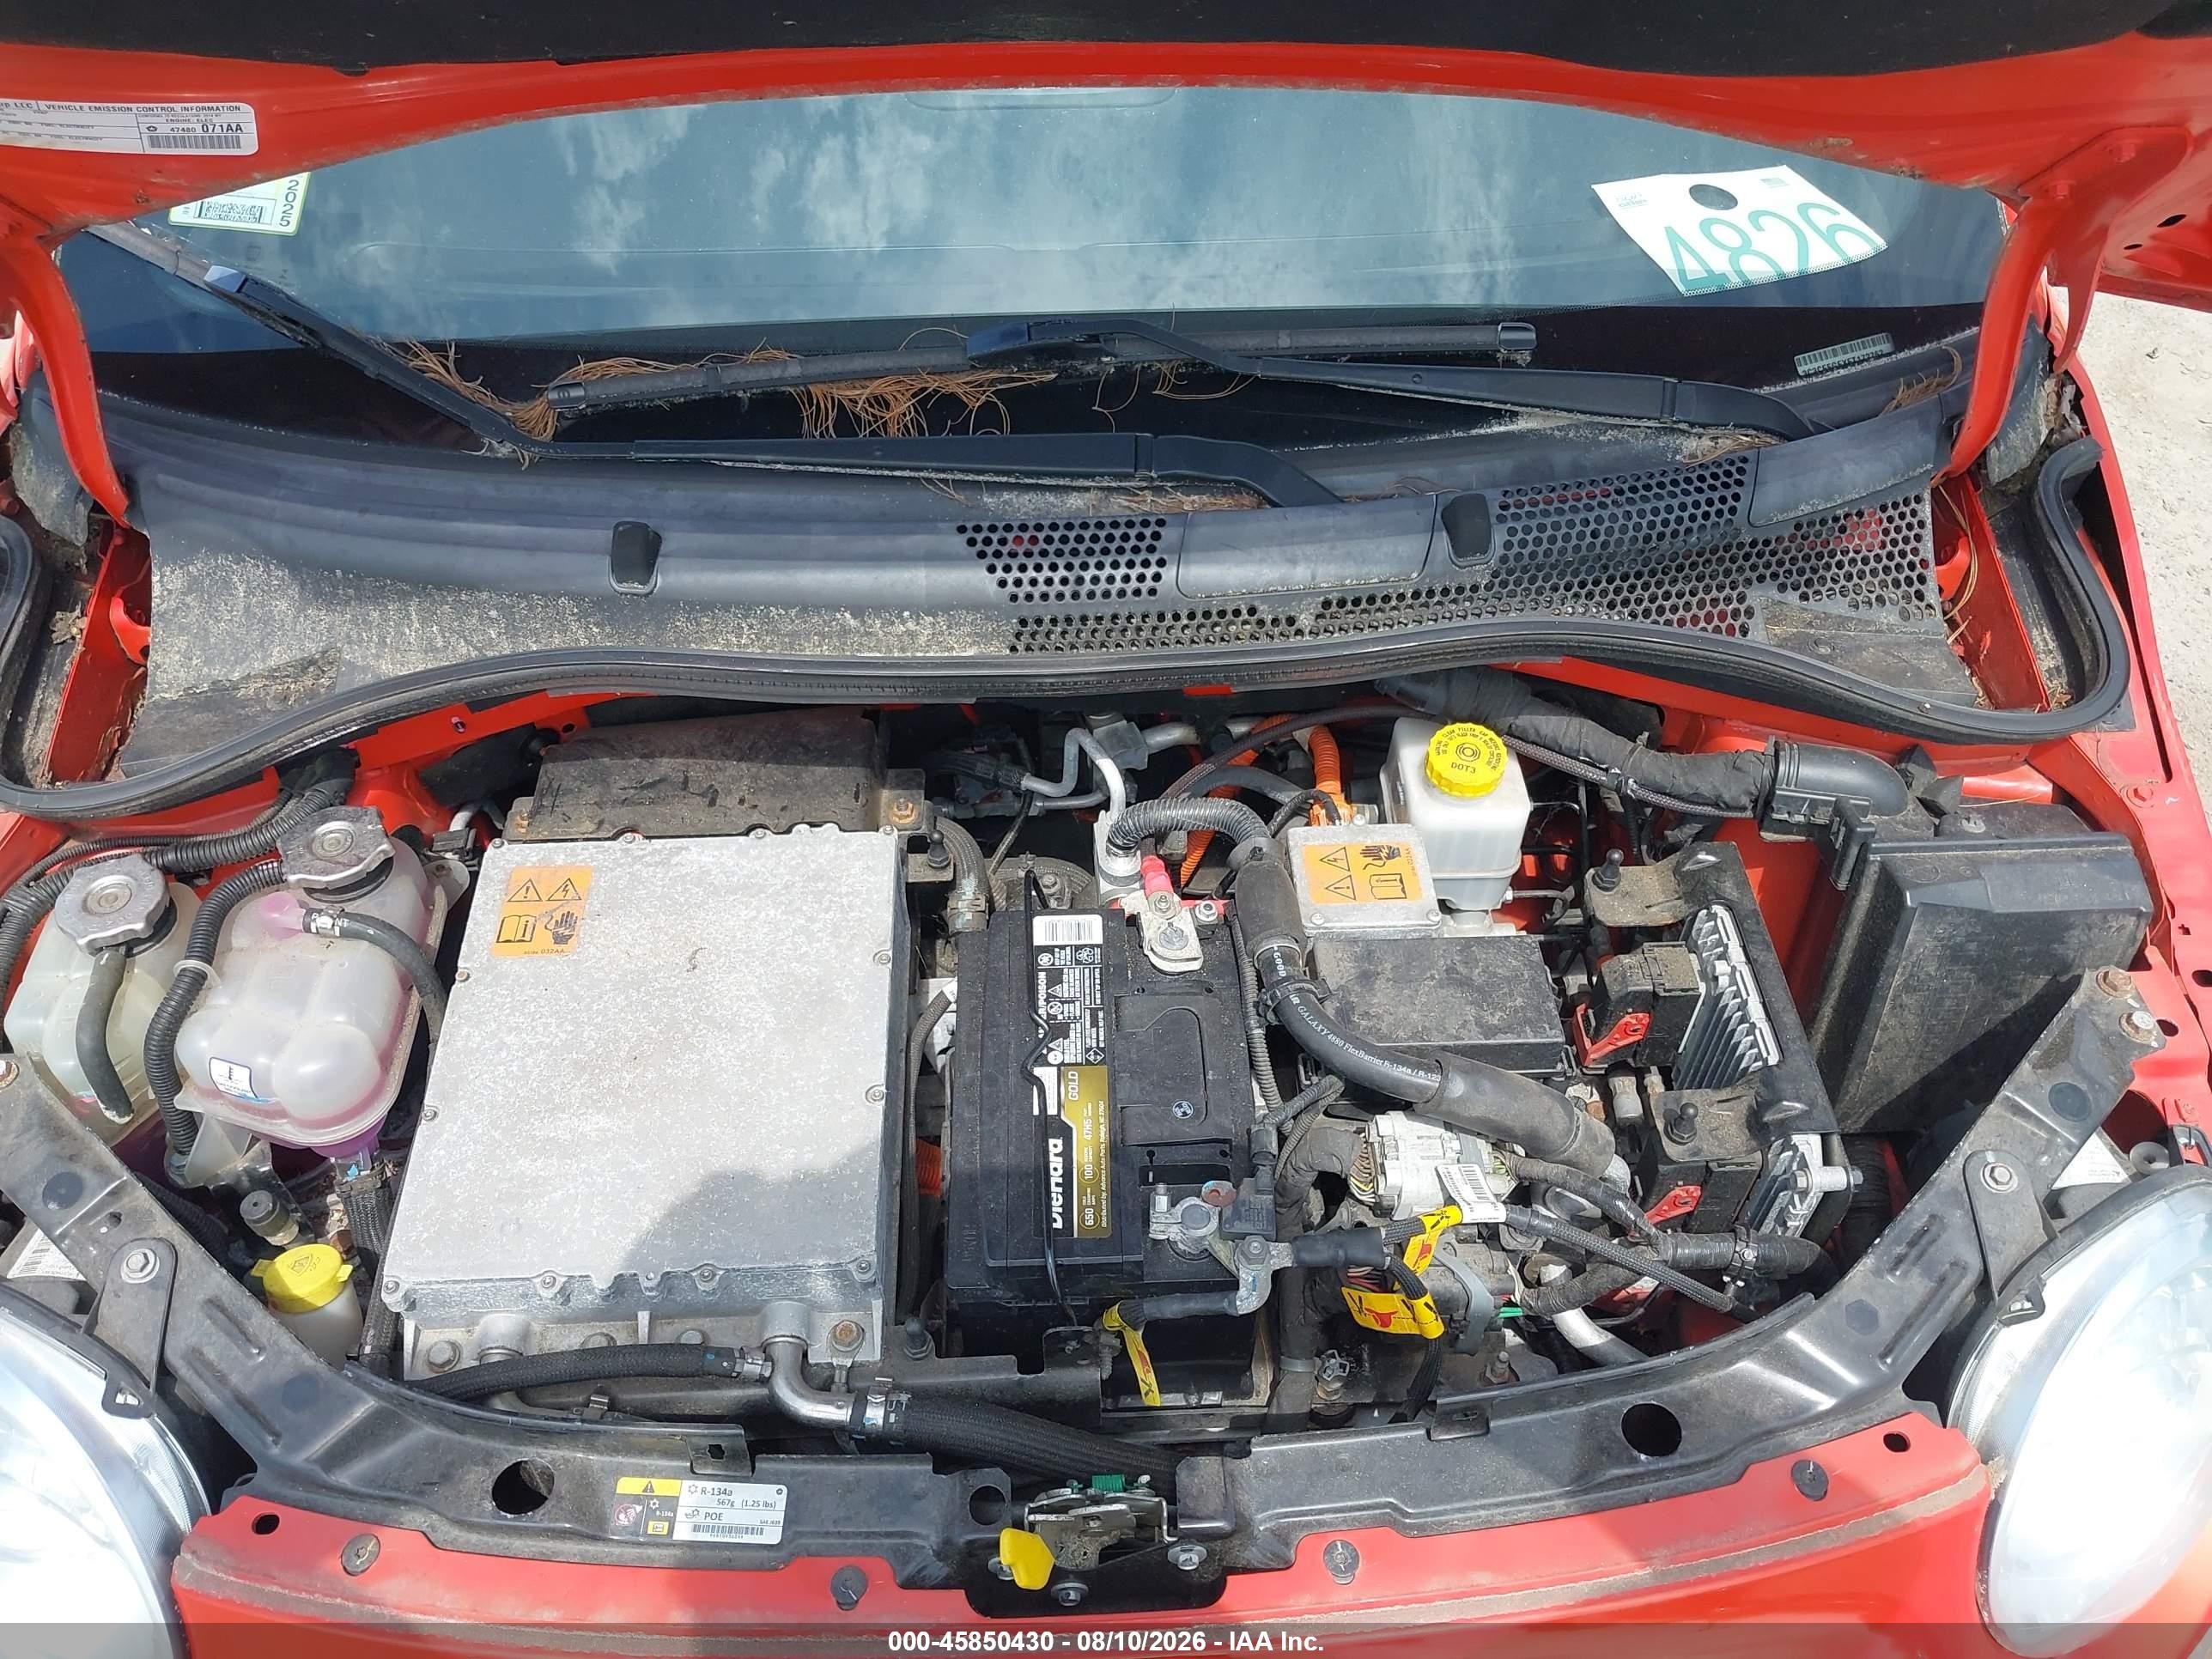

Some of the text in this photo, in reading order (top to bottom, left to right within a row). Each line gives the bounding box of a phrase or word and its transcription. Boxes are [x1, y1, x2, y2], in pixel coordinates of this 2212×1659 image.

[201, 124, 244, 133] 071AA
[279, 179, 300, 227] 2025
[1664, 202, 1878, 290] 4826
[1451, 762, 1476, 774] DOT3
[1297, 1006, 1331, 1036] GALAXY
[1327, 1032, 1345, 1047] 4880
[1343, 1042, 1384, 1066] FlexBarrier
[1383, 1060, 1412, 1075] R-134a
[1067, 1071, 1079, 1101] GOLD
[1083, 1118, 1093, 1140] 47H5
[1085, 1164, 1093, 1180] 100
[1085, 1208, 1094, 1226] 650
[701, 1486, 733, 1497] R-134a
[716, 1498, 777, 1510] 567g (1.25 lbs)
[704, 1511, 724, 1522] POE
